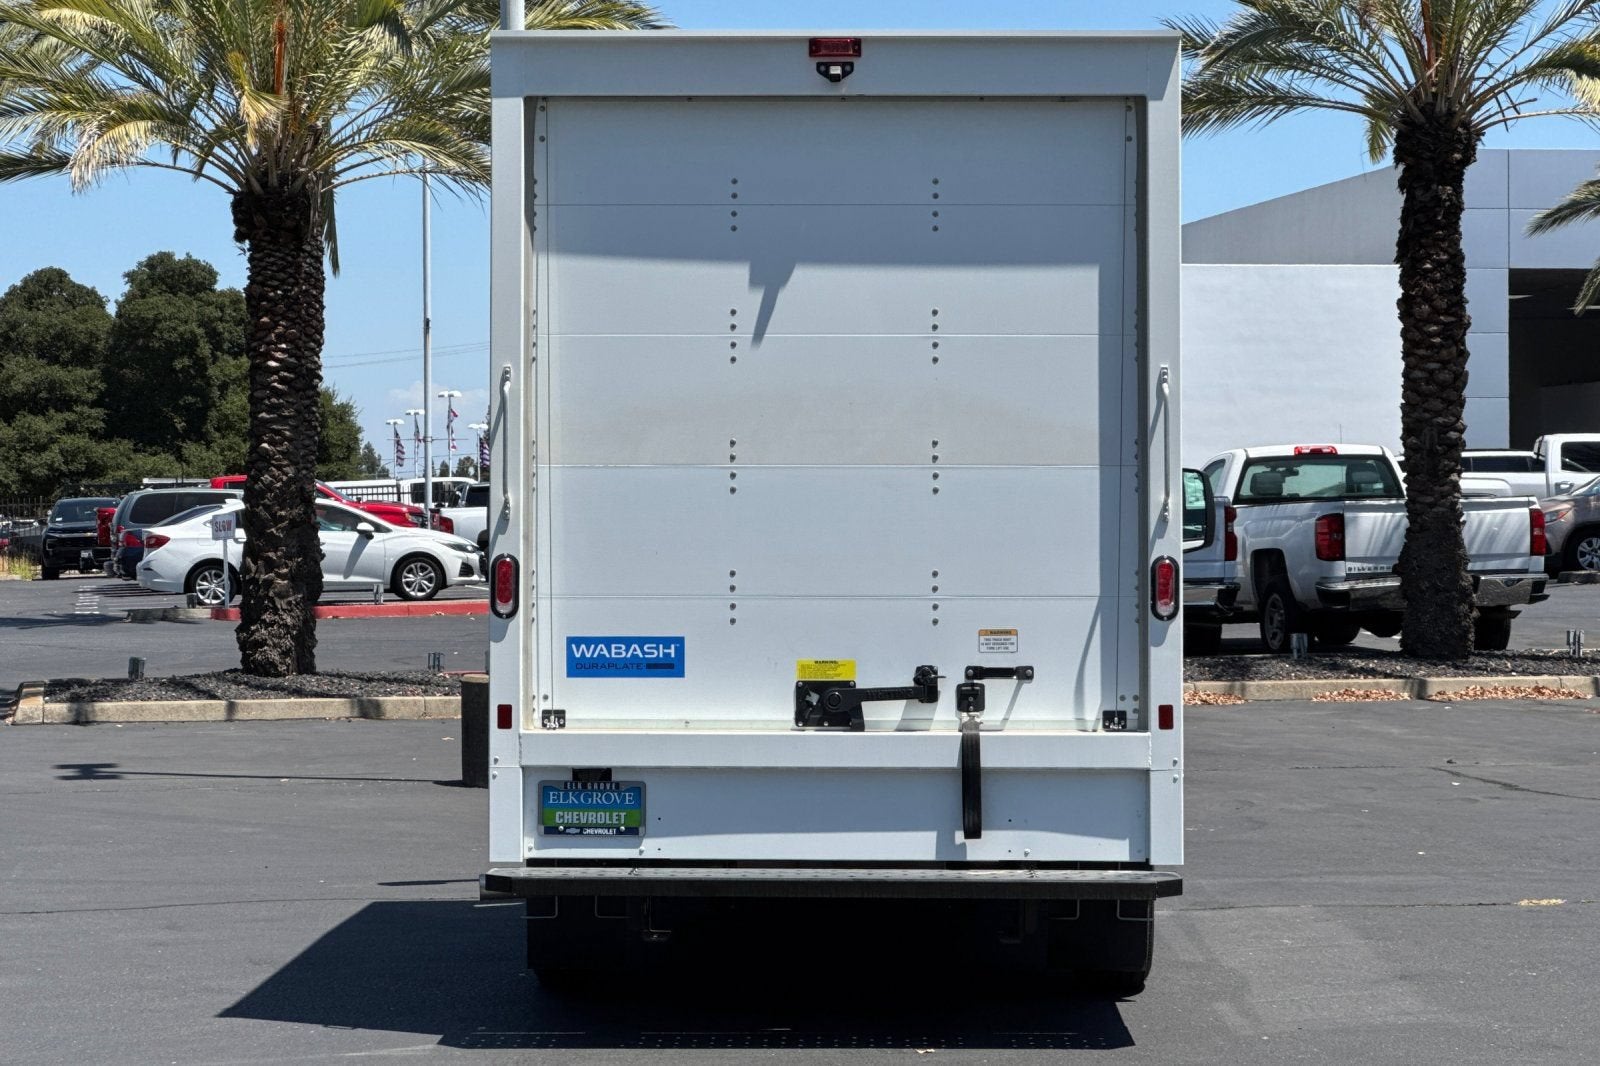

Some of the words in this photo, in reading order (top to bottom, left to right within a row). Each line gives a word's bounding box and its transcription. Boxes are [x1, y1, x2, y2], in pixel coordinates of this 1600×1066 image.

[215, 519, 232, 532] SLOW
[571, 643, 675, 658] WABASH
[575, 662, 643, 670] DURAPLATE
[567, 782, 583, 790] ELK
[587, 782, 616, 790] GROVE
[548, 791, 579, 804] ELK
[580, 791, 635, 805] GROVE
[555, 811, 626, 824] CHEVROLET
